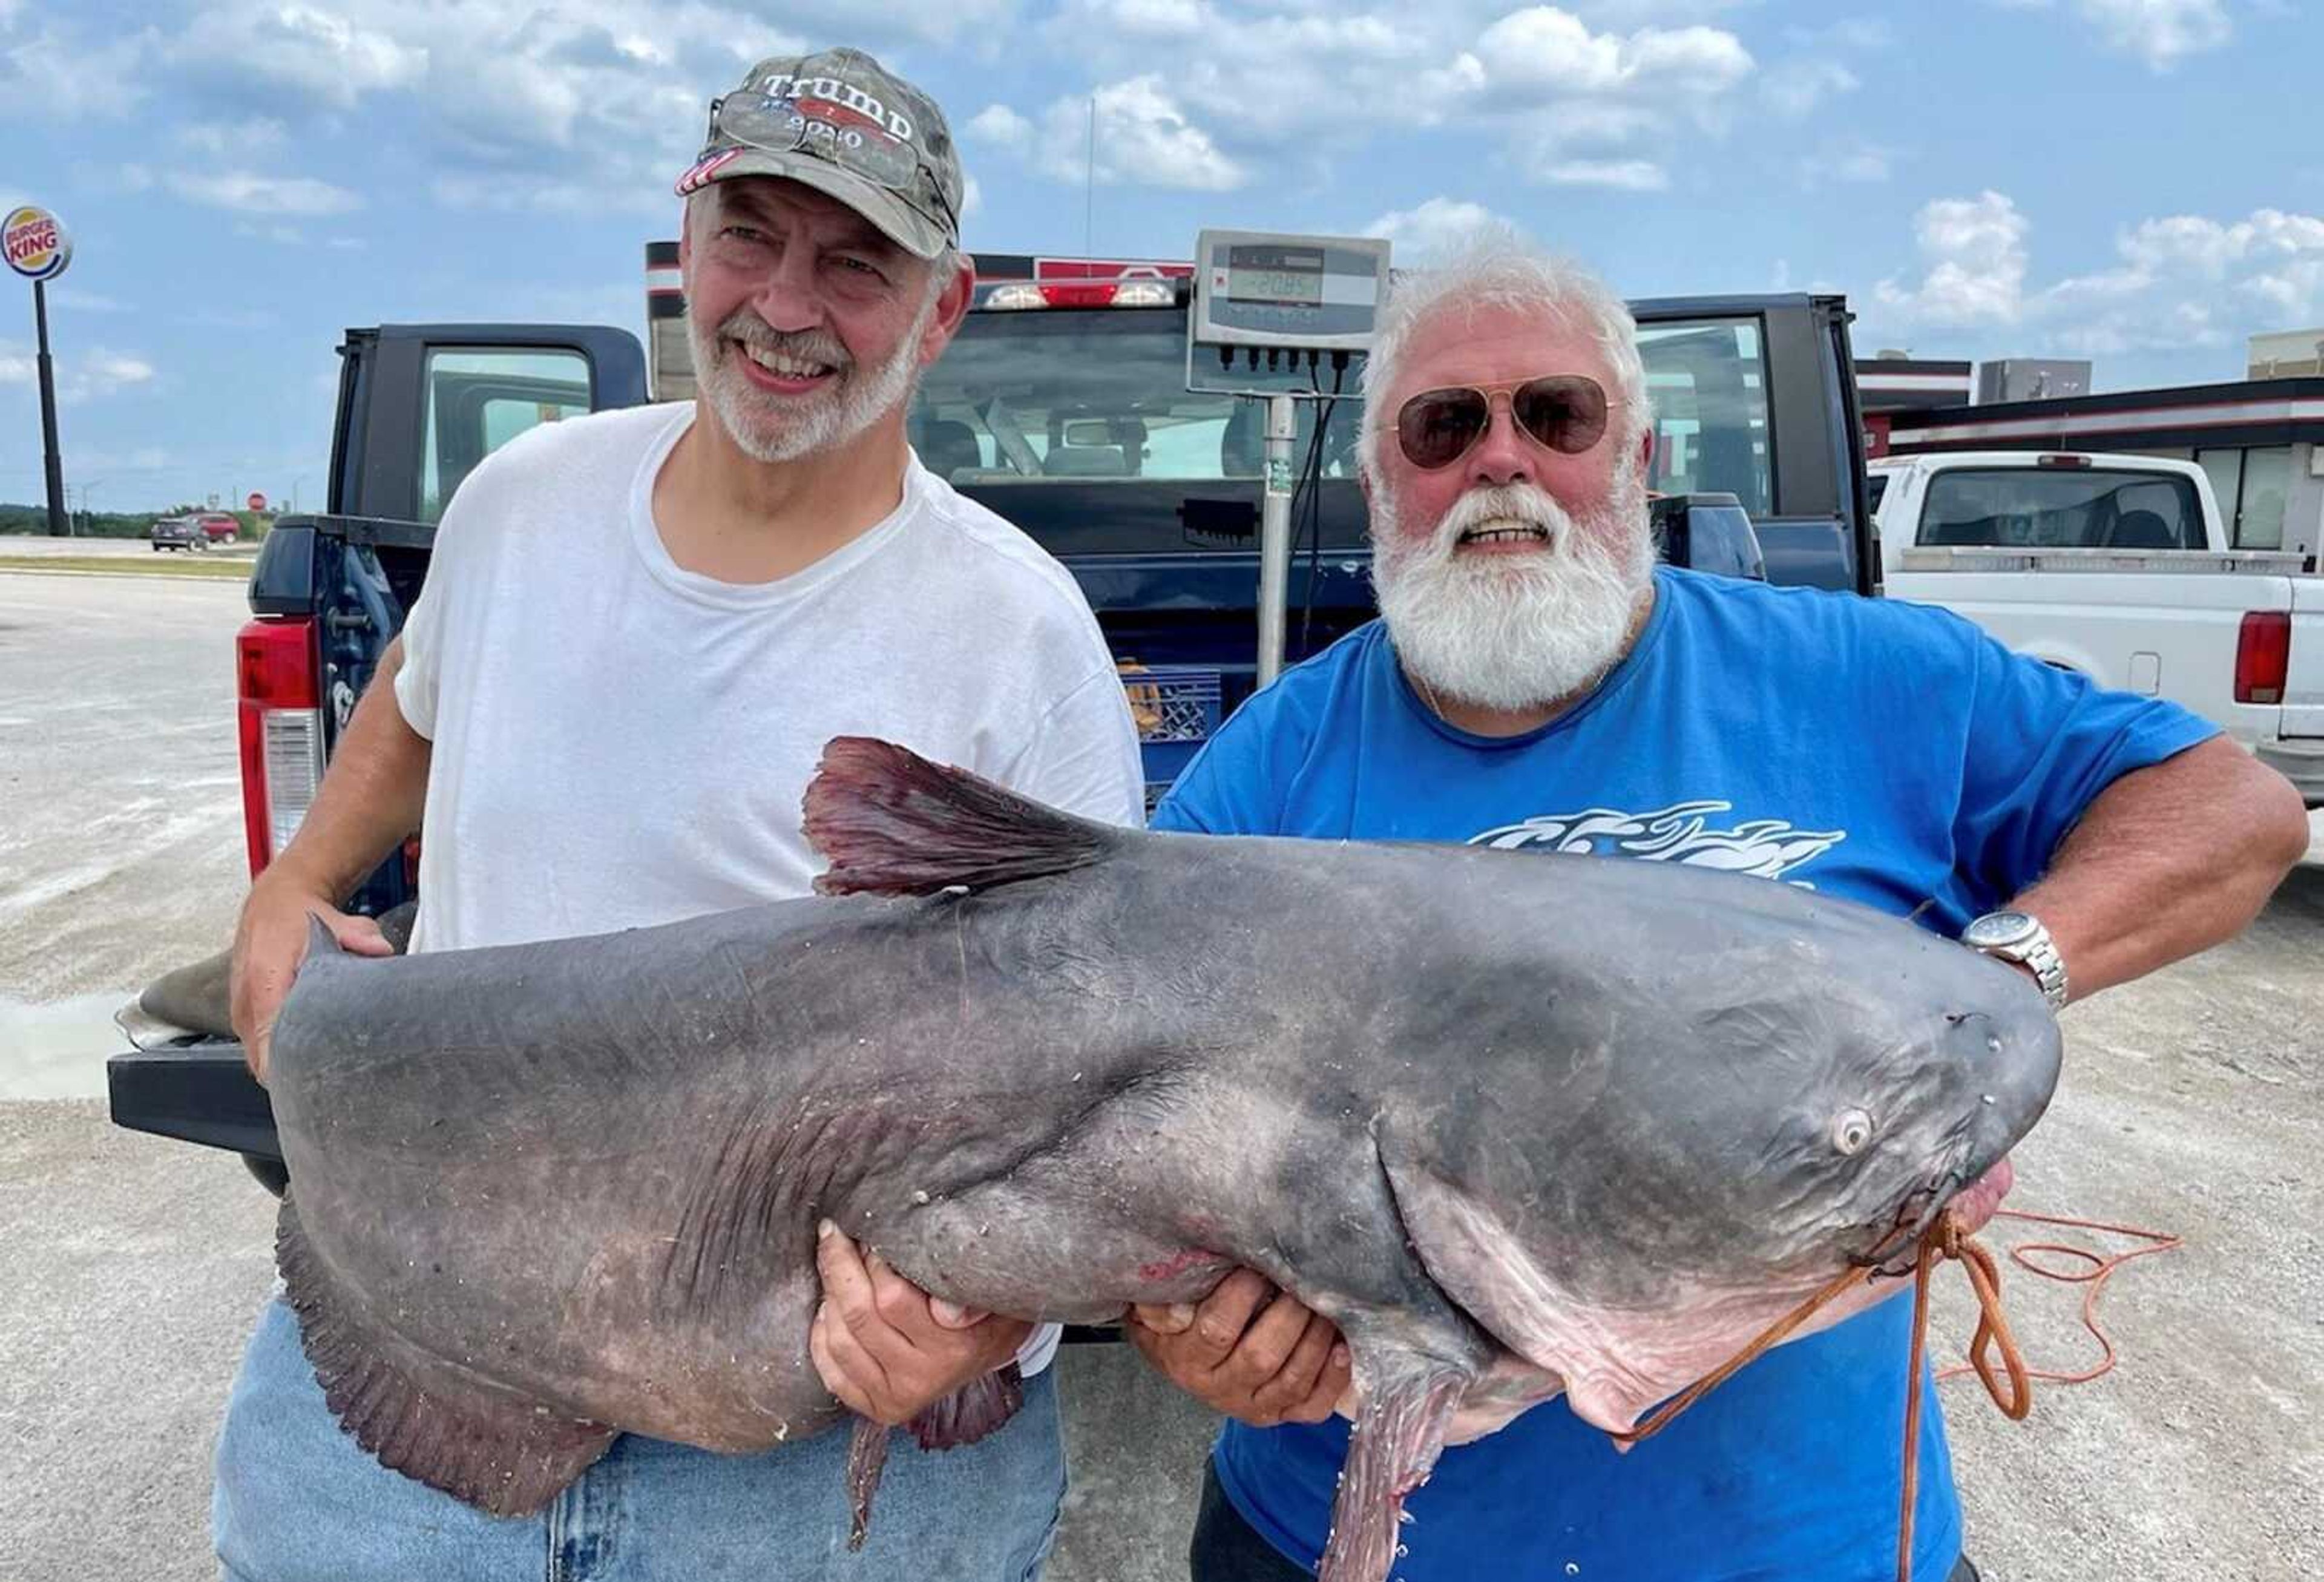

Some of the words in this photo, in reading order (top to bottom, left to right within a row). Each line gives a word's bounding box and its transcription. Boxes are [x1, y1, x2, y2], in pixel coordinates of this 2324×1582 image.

[764, 74, 913, 143] Trump
[6, 218, 56, 245] BURGER
[10, 231, 57, 261] KING
